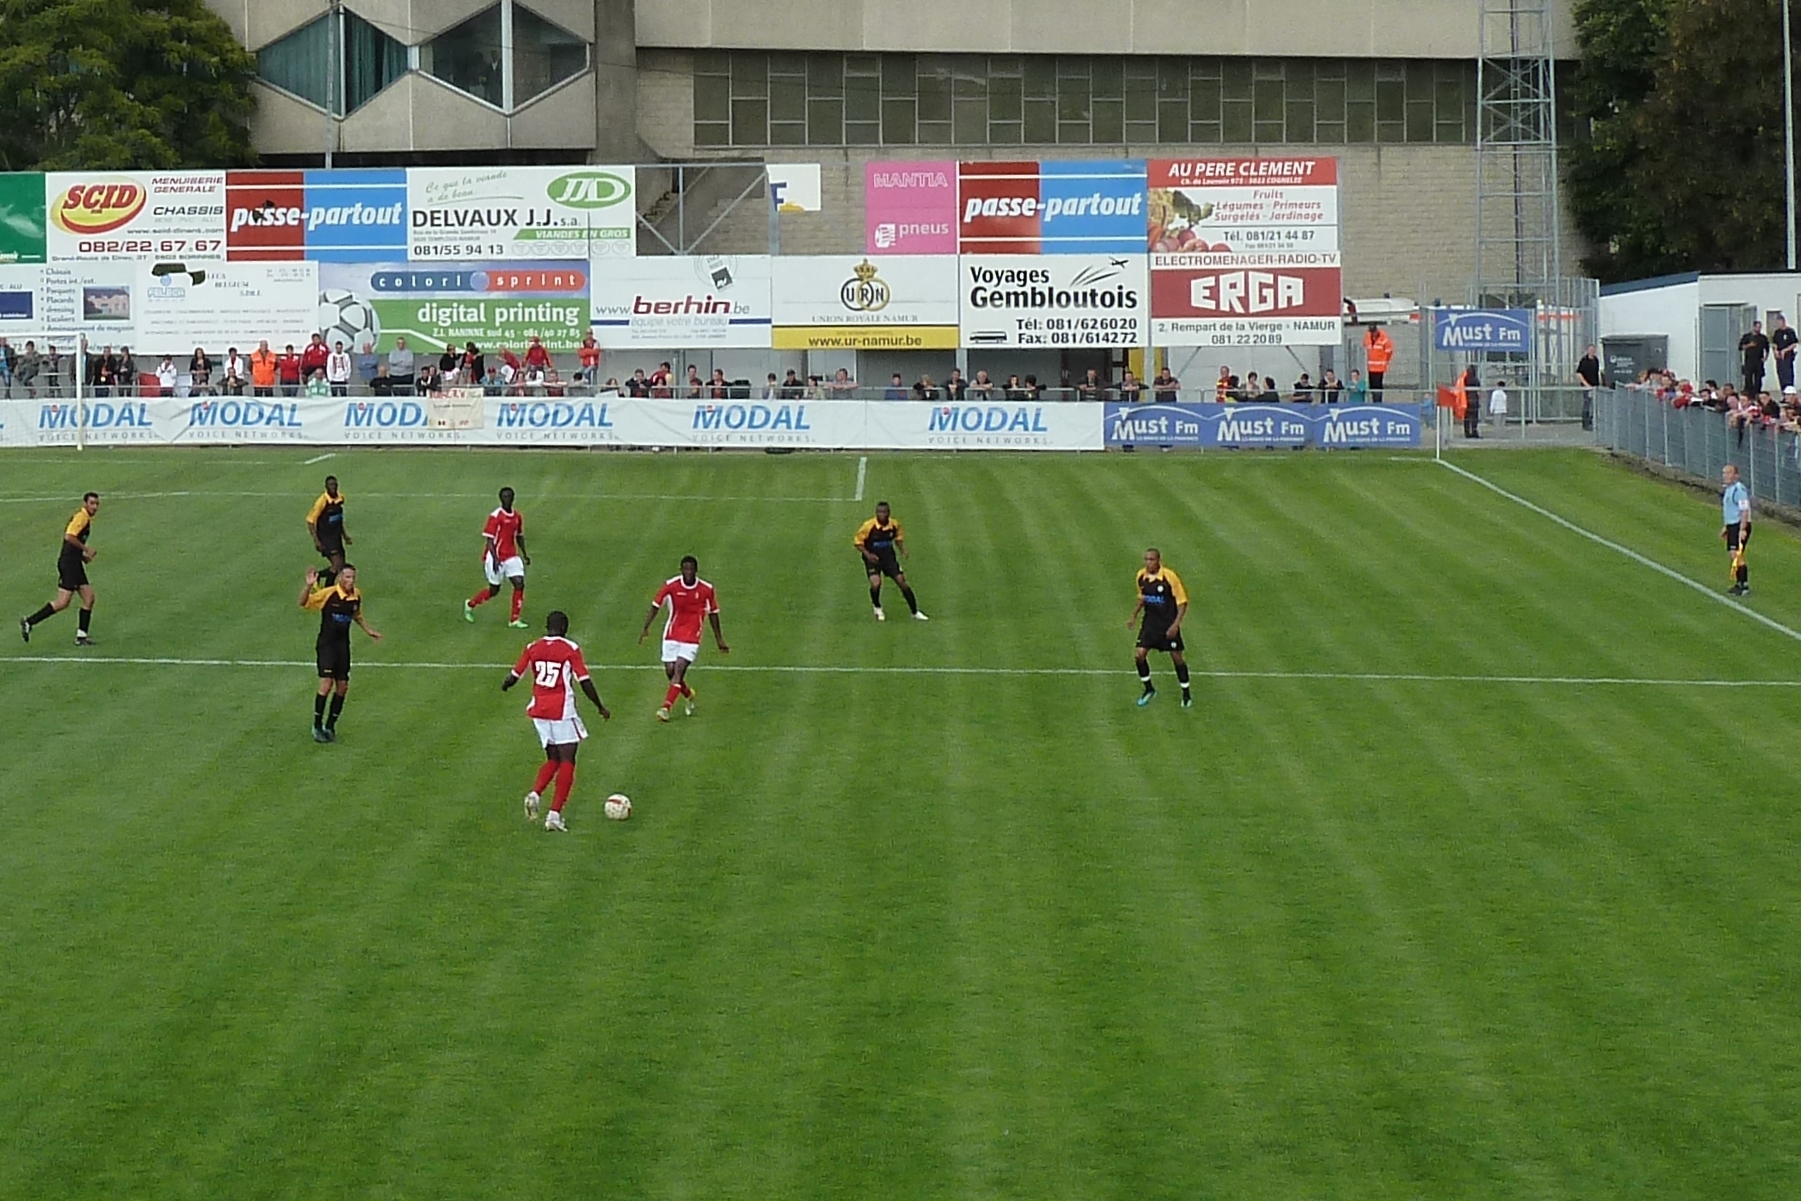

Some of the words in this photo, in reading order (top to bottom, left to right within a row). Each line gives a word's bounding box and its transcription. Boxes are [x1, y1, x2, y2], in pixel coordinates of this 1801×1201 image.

[1169, 163, 1191, 177] AU
[1195, 163, 1235, 176] PERE
[1239, 161, 1316, 176] CLEMENT
[152, 177, 223, 185] MENUISERIE
[426, 181, 440, 194] Ce
[443, 181, 459, 192] que
[476, 171, 507, 182] viande
[873, 172, 948, 187] MANTIA
[63, 184, 137, 209] SCID
[1253, 190, 1284, 199] Fruits
[153, 206, 223, 215] CHASSIS
[964, 192, 1141, 224] passe-partout
[1216, 201, 1263, 211] Légumes
[1273, 201, 1321, 210] Primeurs
[413, 210, 518, 227] DELVAUX
[526, 209, 558, 226] J.J.
[1214, 212, 1260, 222] Surgelés
[1269, 212, 1323, 221] Jardinage
[536, 230, 580, 238] VIANDES
[600, 229, 628, 238] GROS
[899, 223, 949, 237] pneus
[1224, 232, 1243, 241] Tél.
[1246, 231, 1280, 240] 081/21
[1285, 230, 1298, 240] 44
[1303, 230, 1314, 239] 87
[79, 241, 221, 252] 082/22.67.67
[414, 245, 461, 255] 081/55
[466, 245, 482, 255] 94
[488, 244, 503, 254] 13
[1156, 253, 1336, 266] ELECTROMENAGER-RADIO-TV
[970, 267, 1050, 288] Voyages
[846, 288, 884, 302] URN
[970, 285, 1137, 309] Gembloutois
[1191, 271, 1303, 313] ERGA
[596, 295, 750, 315] www.berhin.be
[418, 303, 486, 326] digital
[495, 302, 580, 326] printing
[667, 317, 691, 326] votre
[693, 316, 727, 325] bureau
[448, 328, 484, 337] NANINNE
[487, 327, 502, 337] sud
[505, 328, 515, 337] 45
[570, 327, 580, 337] 85
[1016, 318, 1042, 331] Tél:
[1047, 318, 1137, 331] 081/626020
[1172, 322, 1216, 332] Rempart
[1219, 322, 1232, 331] de
[1236, 322, 1245, 330] la
[1249, 322, 1282, 332] Vierge
[1294, 321, 1335, 330] NAMUR
[809, 335, 921, 346] www.ur-namur.be
[1018, 332, 1046, 344] Fax:
[1051, 331, 1137, 344] 081/614272
[1442, 323, 1492, 347] Must
[39, 402, 153, 429] MODAL
[189, 401, 303, 428] MODAL
[344, 402, 429, 428] MOD
[497, 402, 613, 428] MODAL
[692, 405, 811, 431] MODAL
[928, 406, 1048, 432] MODAL
[1112, 417, 1168, 441] Must
[1217, 417, 1273, 442] Must
[1323, 417, 1379, 443] Must
[535, 661, 561, 688] 25
